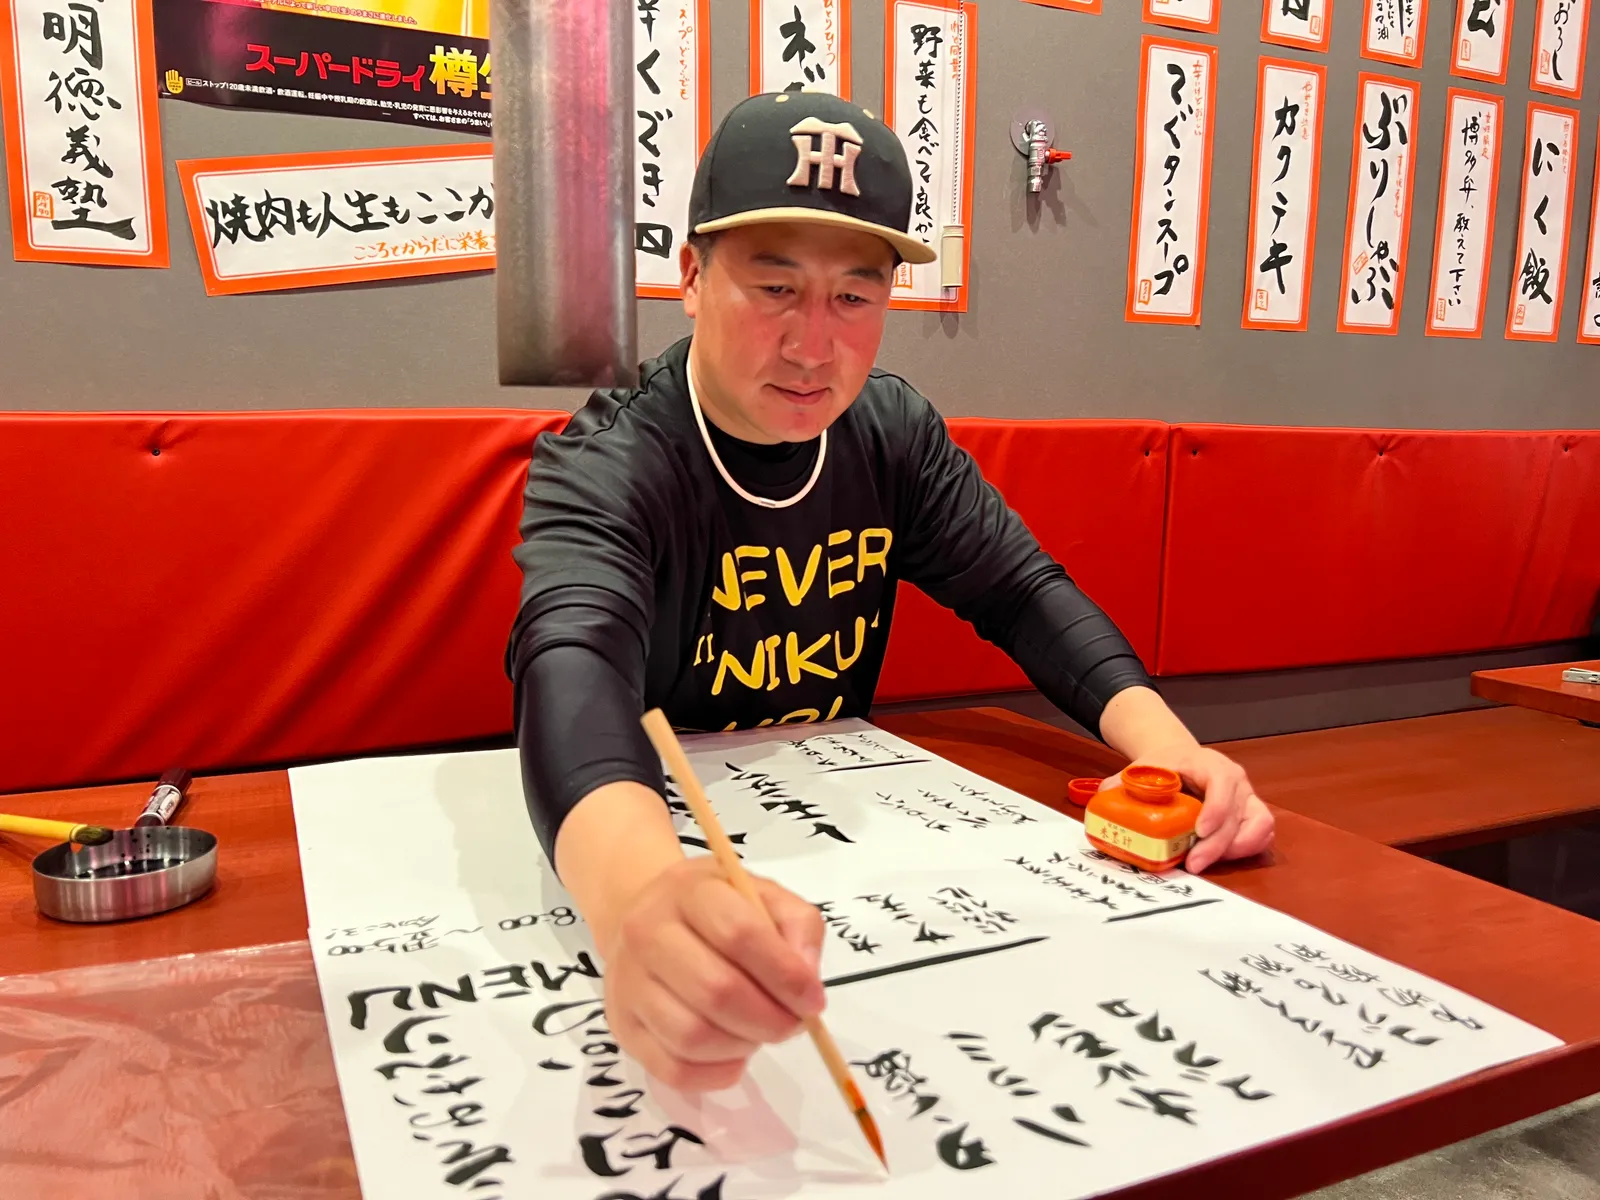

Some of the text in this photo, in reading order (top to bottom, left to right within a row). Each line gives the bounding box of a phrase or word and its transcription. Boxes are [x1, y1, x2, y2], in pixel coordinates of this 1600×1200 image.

[908, 24, 944, 243] 野菜も食べて良か
[354, 229, 495, 261] こころとからだに栄養
[1260, 96, 1299, 294] カクテキ
[498, 906, 587, 931] 8:00
[347, 951, 601, 1029] MENU
[944, 1032, 1091, 1148] ハラミ
[1028, 1012, 1197, 1126] ホルモン
[1097, 999, 1275, 1101] コブクロ
